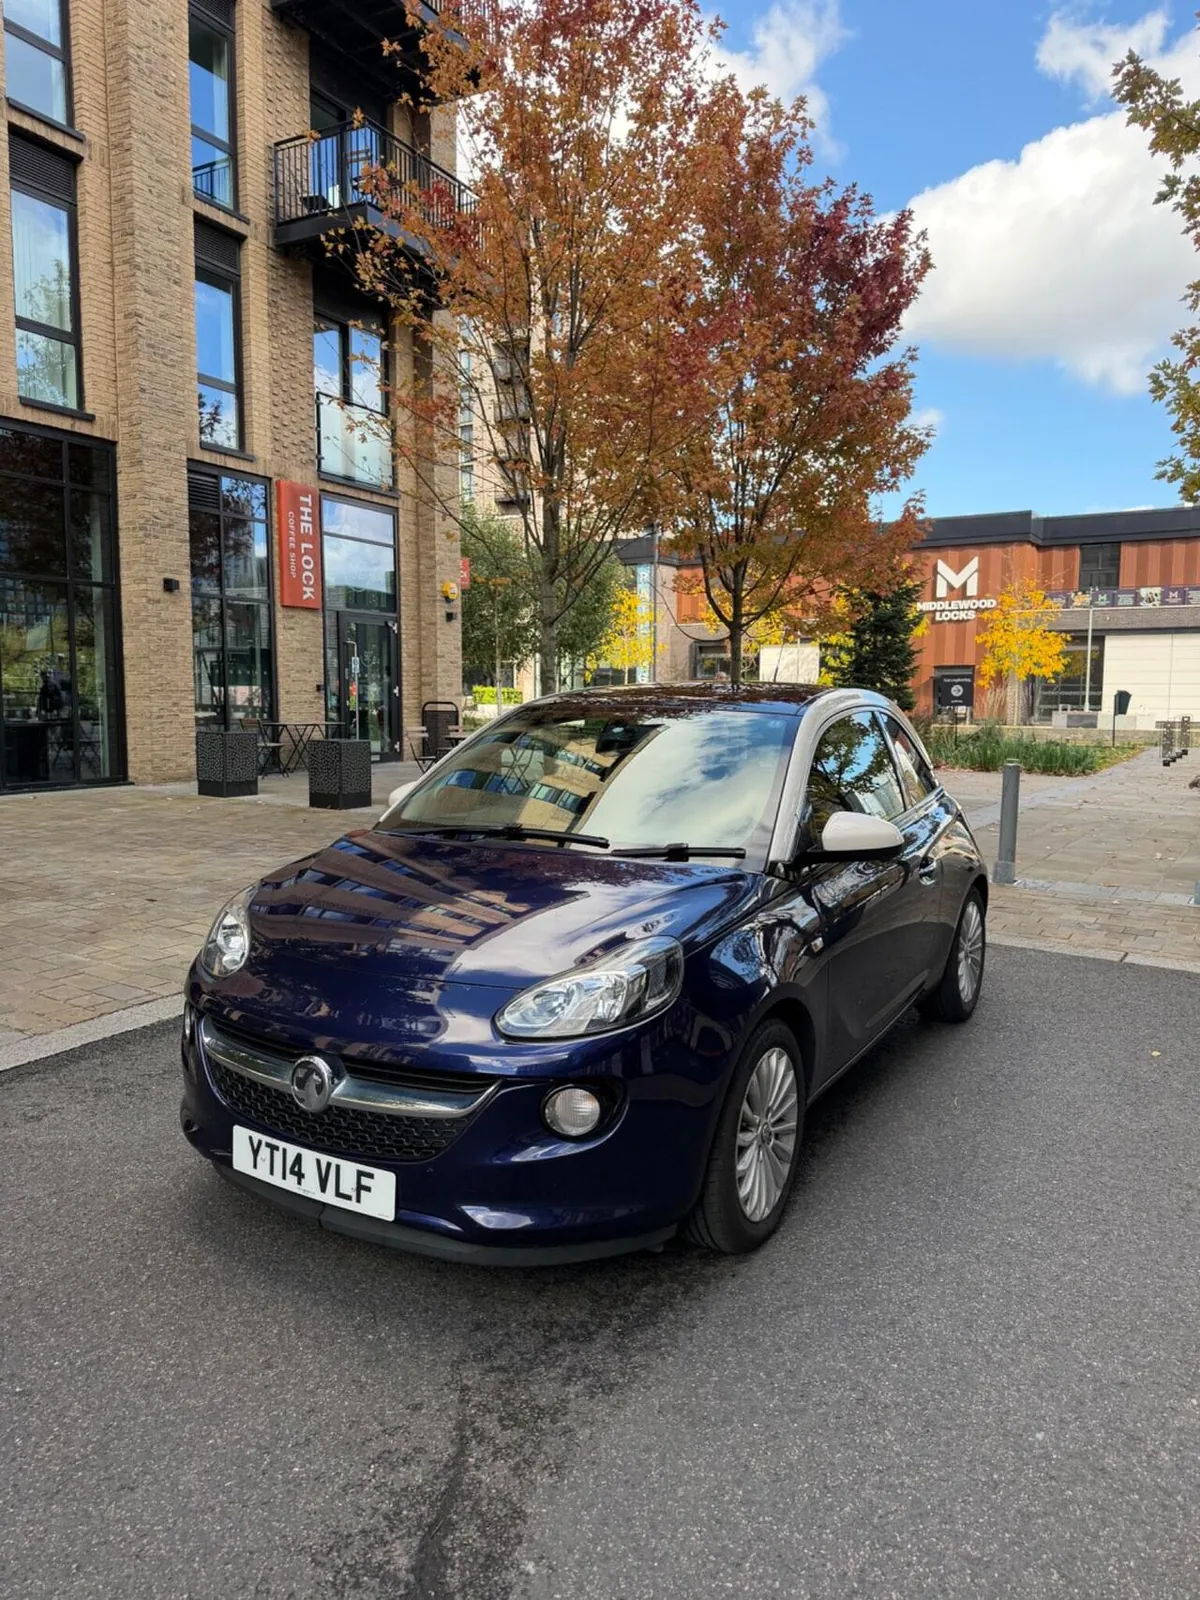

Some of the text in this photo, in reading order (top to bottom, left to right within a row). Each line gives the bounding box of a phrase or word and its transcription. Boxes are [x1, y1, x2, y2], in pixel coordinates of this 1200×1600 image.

[288, 511, 297, 578] COFFEE SHOP
[300, 494, 316, 600] THE LOCK
[936, 556, 979, 598] M
[916, 599, 997, 612] MIDDLEWOOD
[935, 610, 976, 621] LOCKS
[248, 1135, 375, 1205] YT14 VLF
